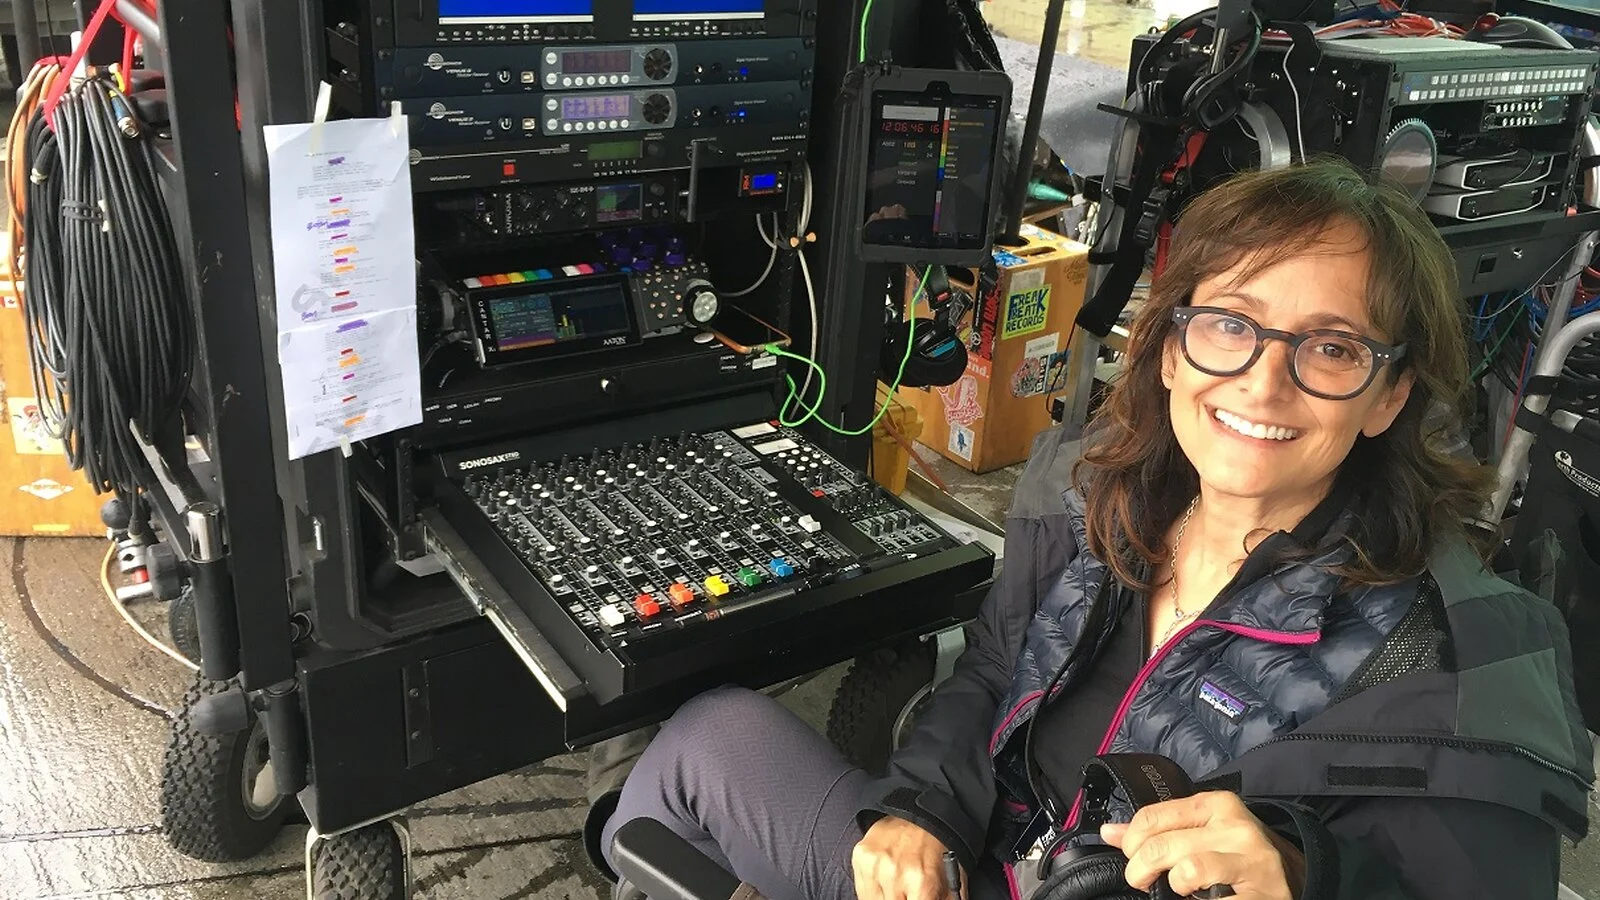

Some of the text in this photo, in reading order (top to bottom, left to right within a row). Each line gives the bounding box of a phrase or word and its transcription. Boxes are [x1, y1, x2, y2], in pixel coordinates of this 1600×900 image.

[1009, 288, 1049, 316] FREAK
[1006, 314, 1045, 332] RECORDS
[459, 455, 506, 470] SONOSAX
